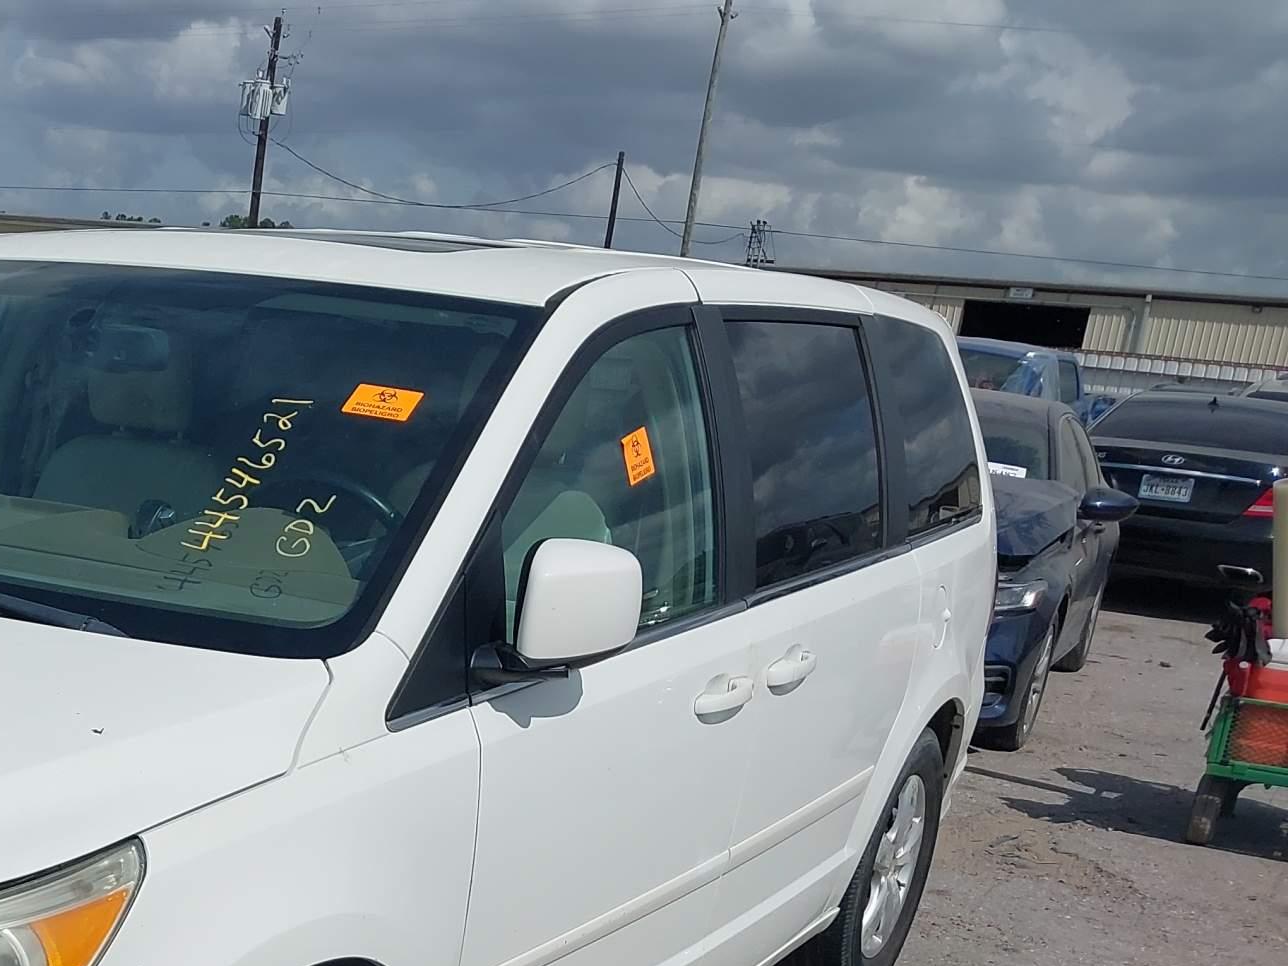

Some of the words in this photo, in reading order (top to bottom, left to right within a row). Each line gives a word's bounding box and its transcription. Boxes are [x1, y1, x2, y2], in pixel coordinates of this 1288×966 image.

[351, 407, 400, 418] BIOPELIGRO
[354, 401, 404, 413] BIOHAZARD
[180, 398, 314, 550] 44546521
